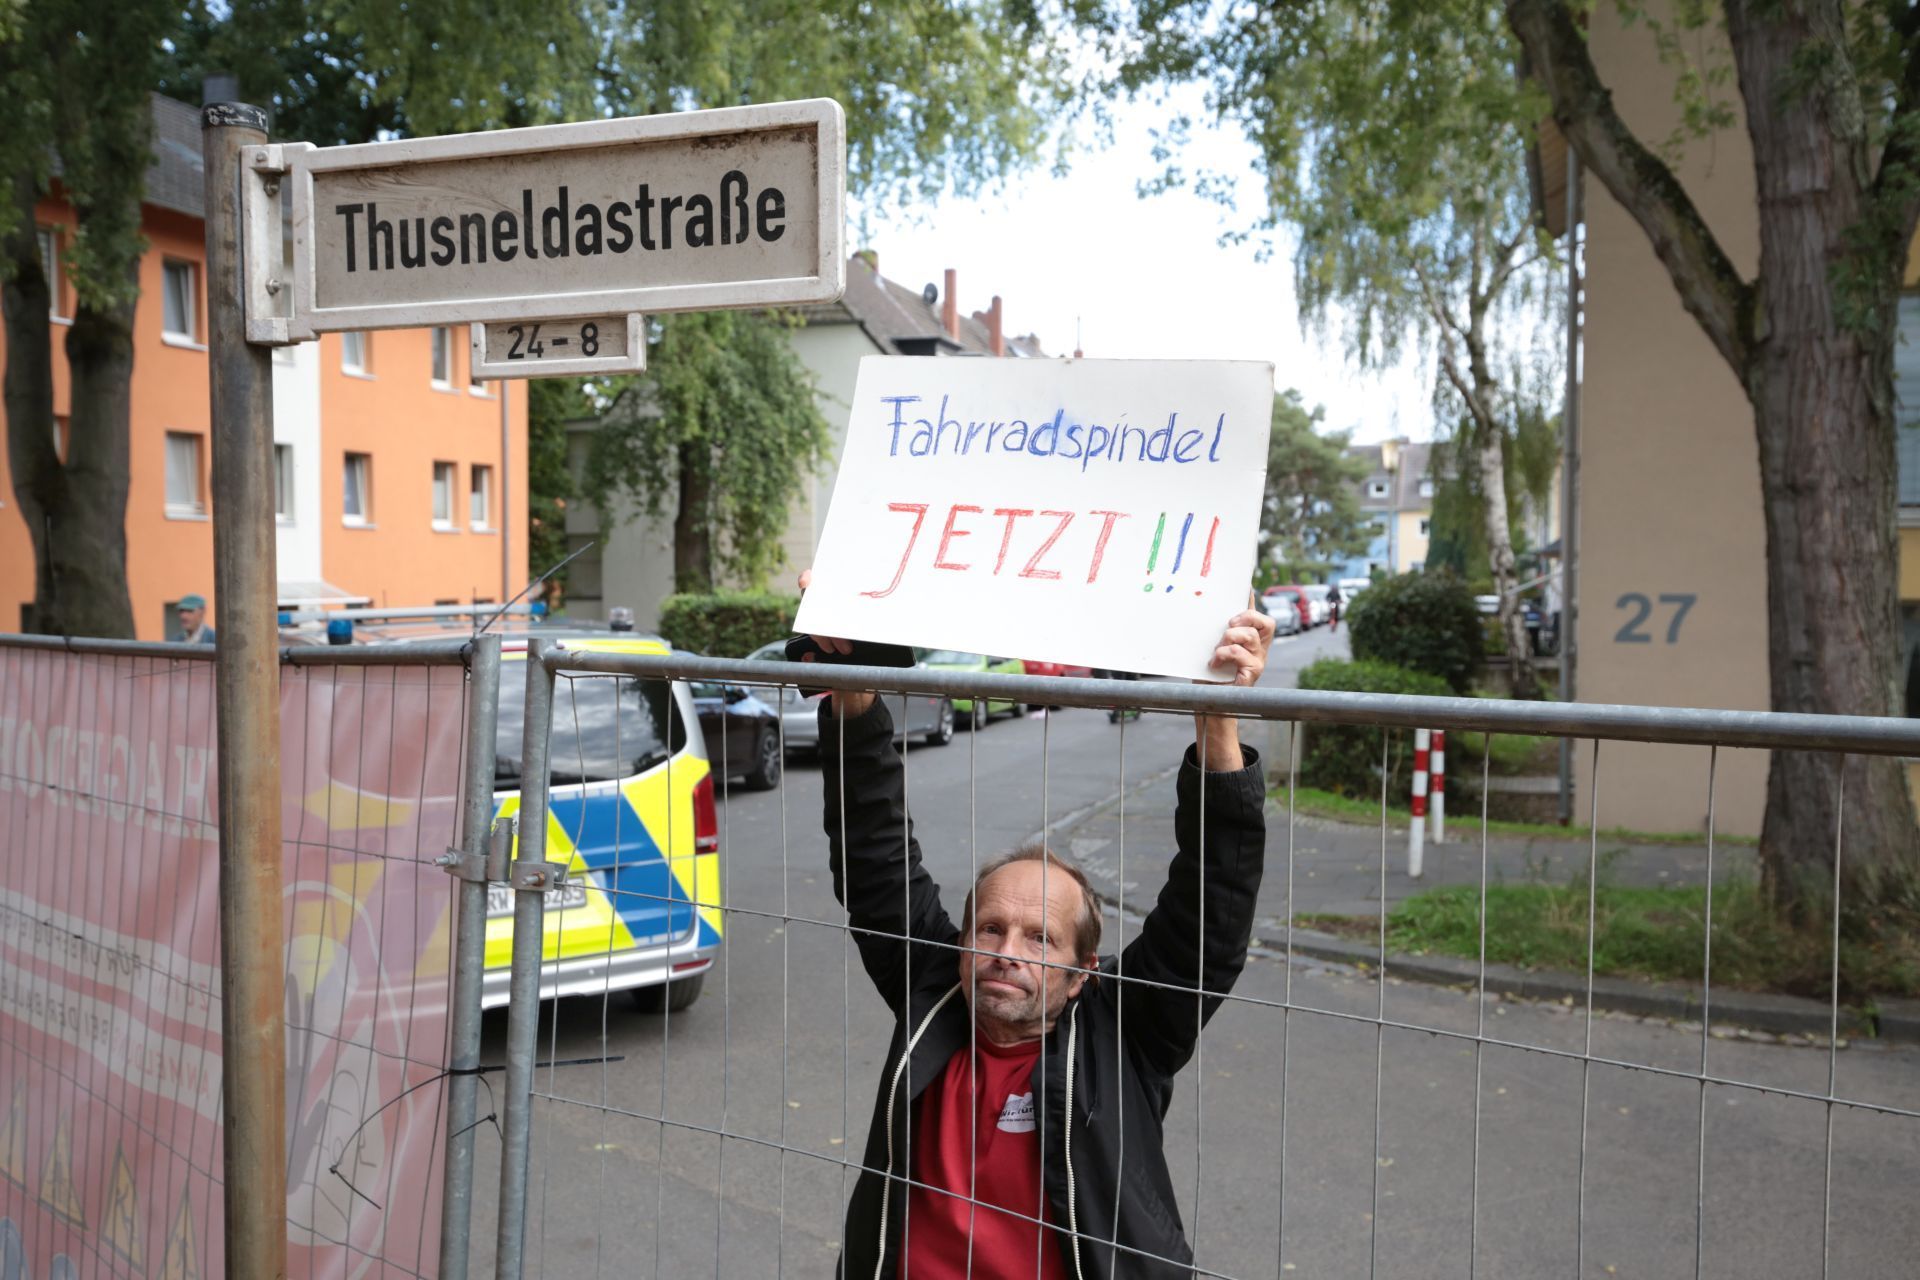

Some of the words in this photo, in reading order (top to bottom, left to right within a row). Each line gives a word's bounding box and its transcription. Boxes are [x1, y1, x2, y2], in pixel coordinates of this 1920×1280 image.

[336, 170, 787, 273] Thusneldastraße
[880, 394, 1225, 472] Fahrradspindel
[1613, 591, 1698, 644] 27
